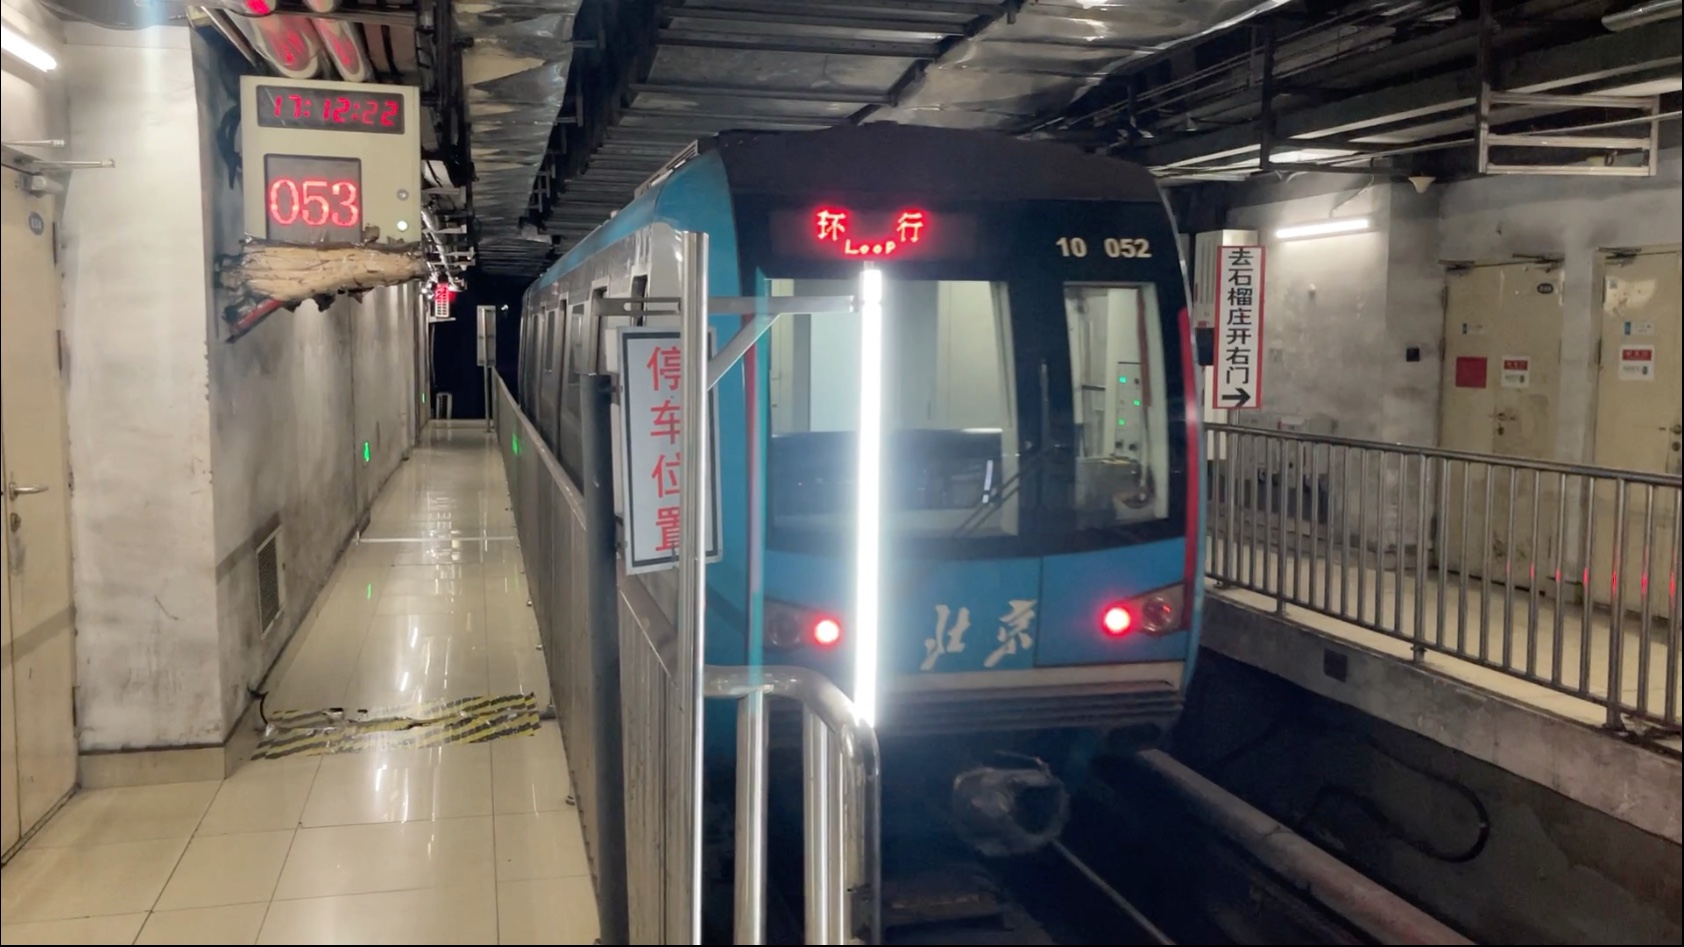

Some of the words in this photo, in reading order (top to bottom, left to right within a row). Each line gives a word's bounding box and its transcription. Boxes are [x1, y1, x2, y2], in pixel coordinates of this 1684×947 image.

[273, 95, 398, 126] 17:12:22
[270, 179, 359, 226] 053
[1056, 237, 1087, 258] 10
[1104, 238, 1152, 258] 052
[1226, 248, 1254, 385] 去石榴庄开右门
[920, 599, 1038, 671] 北京
